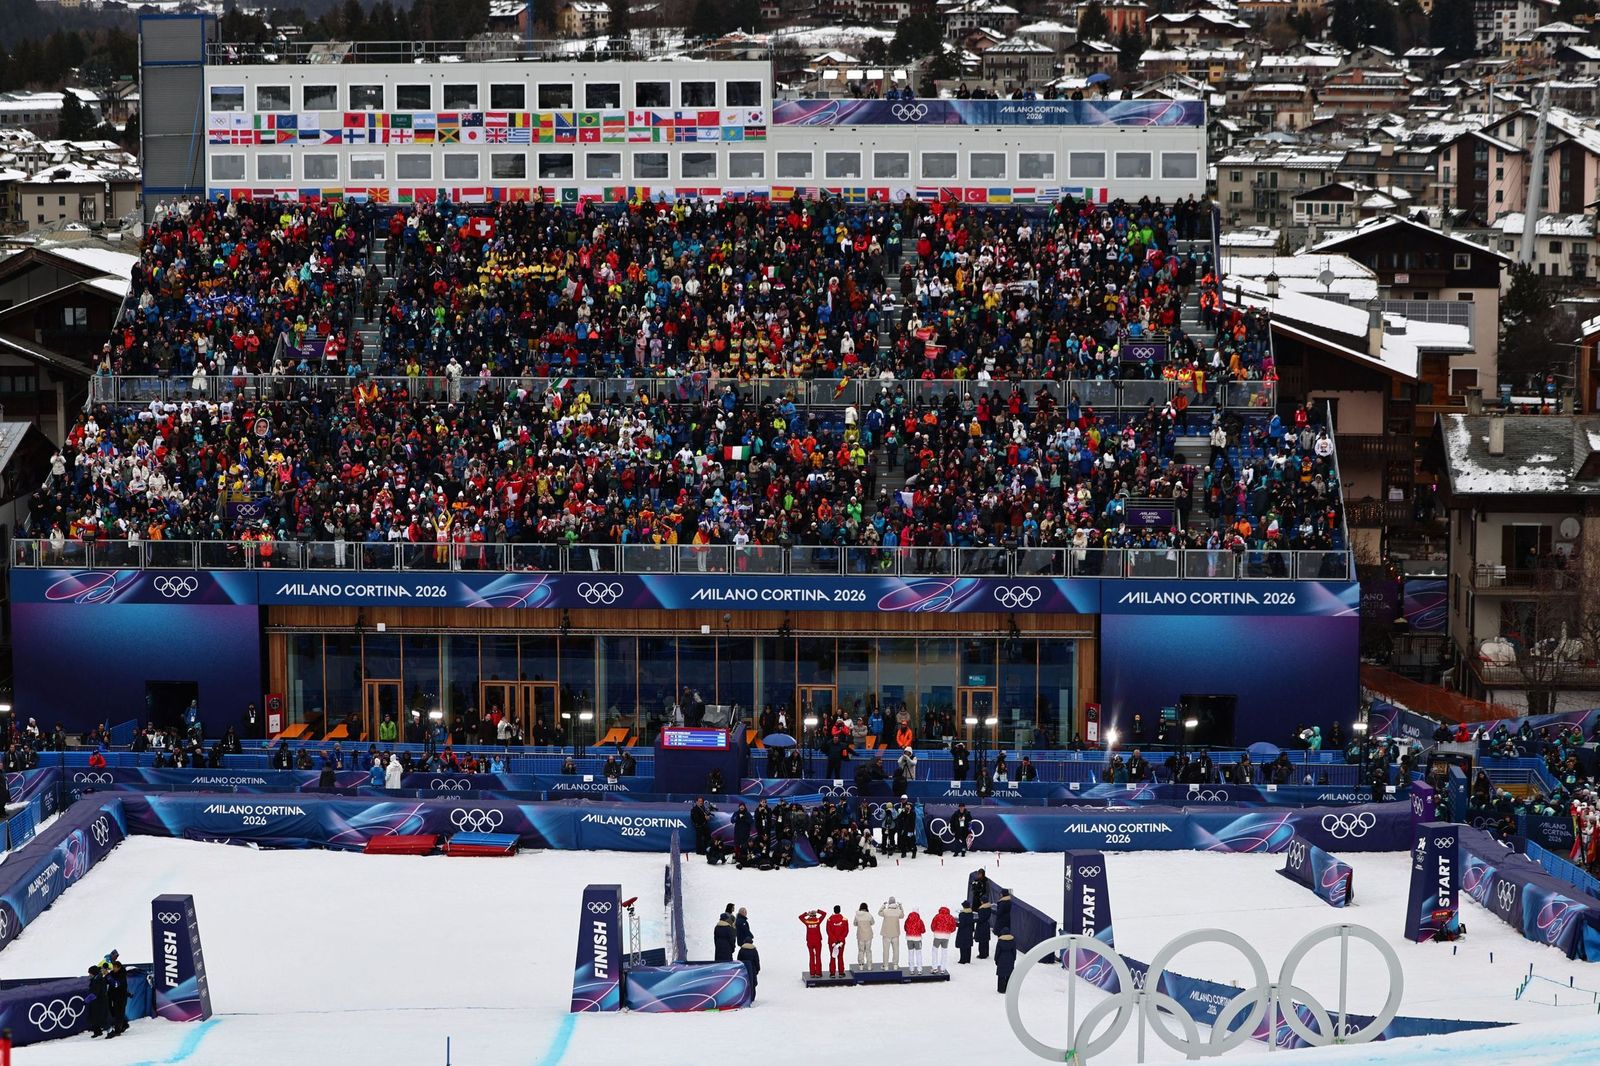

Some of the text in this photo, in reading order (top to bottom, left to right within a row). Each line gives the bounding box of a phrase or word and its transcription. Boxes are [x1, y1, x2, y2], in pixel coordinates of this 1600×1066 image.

[276, 583, 447, 598] MILANO CORTINA 2026
[690, 588, 866, 601] MILANO CORTINA 2026
[1118, 591, 1296, 605] MILANO CORTINA 2026
[191, 776, 267, 785] MILANO CORTINA
[552, 783, 630, 792] MILANO CORTINA
[991, 789, 1022, 798] ORTINA
[1317, 793, 1397, 801] MILANO CONA
[203, 804, 307, 816] MILANO CORTINA
[242, 815, 267, 826] 2026
[580, 813, 688, 829] MILANO CORTINA
[1538, 822, 1567, 830] MILANO
[621, 826, 646, 837] 2026
[1063, 823, 1173, 833] MILANO CORTINA
[1542, 828, 1572, 837] CORTINA
[1105, 834, 1131, 844] 2026
[1438, 855, 1450, 907] START
[1082, 884, 1096, 938] START
[593, 920, 608, 979] FINISH
[164, 930, 178, 988] FINISH
[1189, 990, 1213, 1003] MILANO
